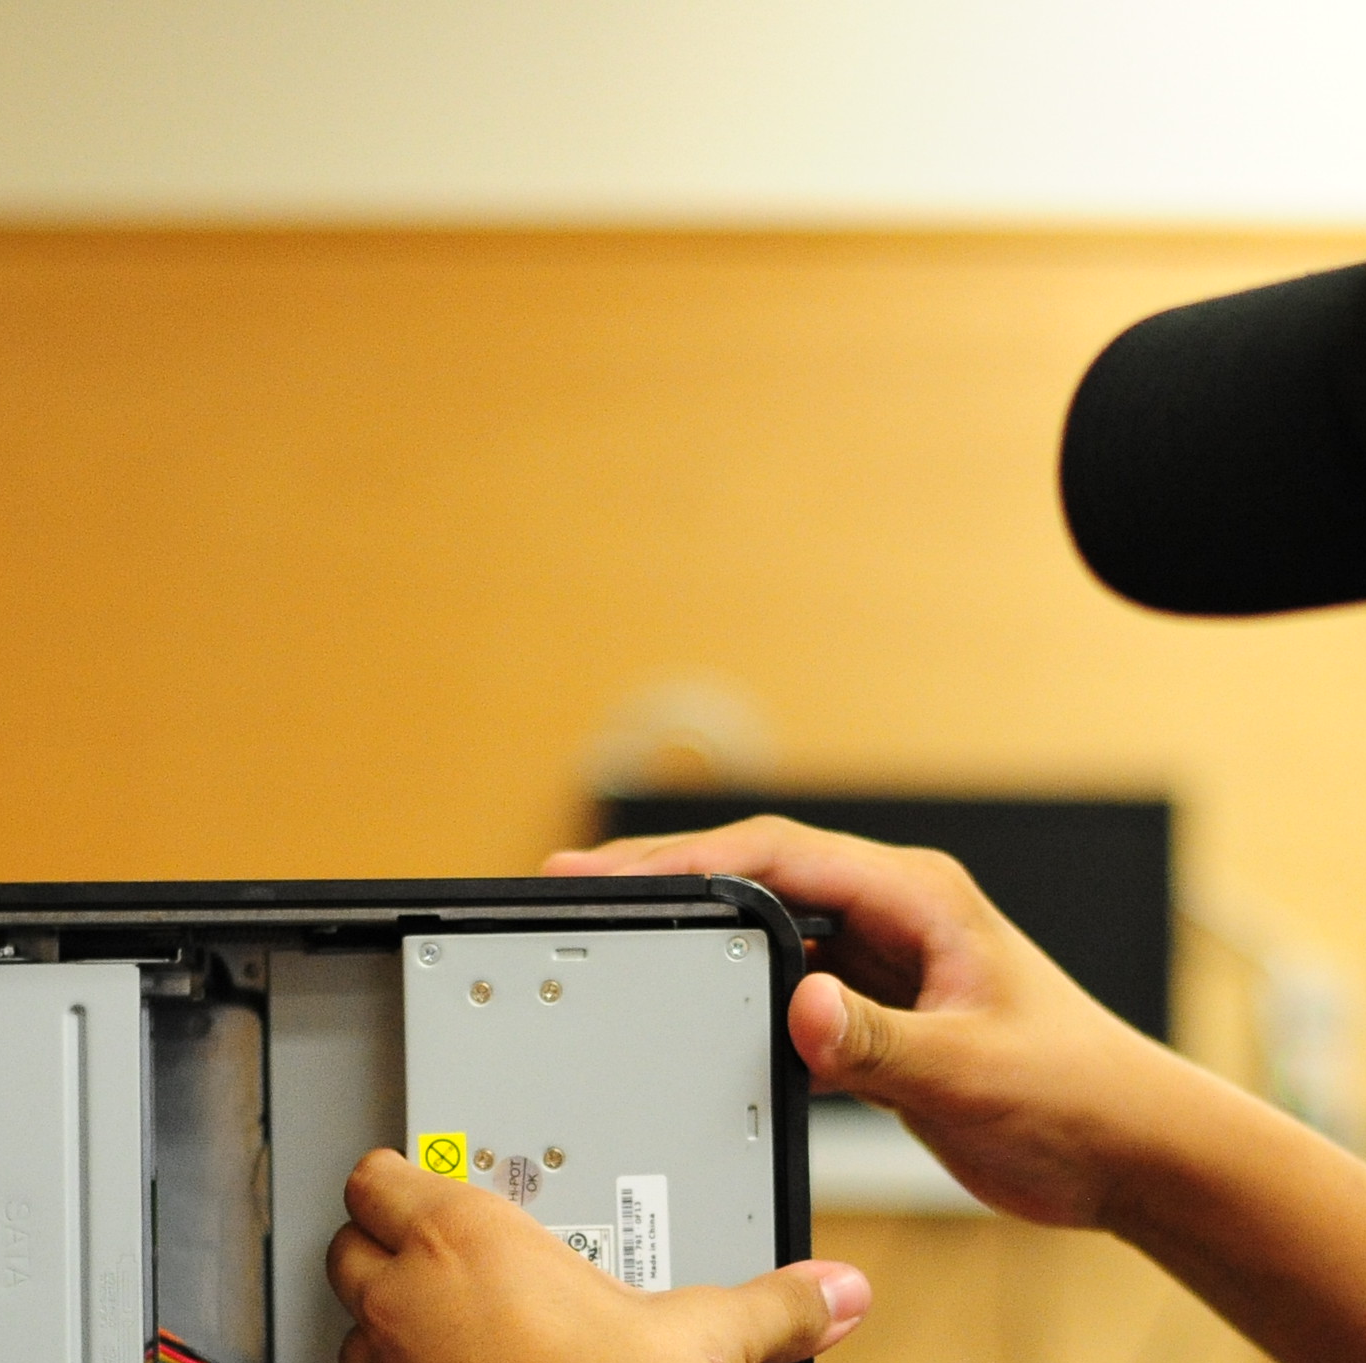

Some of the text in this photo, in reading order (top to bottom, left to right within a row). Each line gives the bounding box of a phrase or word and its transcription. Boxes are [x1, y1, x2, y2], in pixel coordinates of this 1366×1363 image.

[526, 1173, 538, 1192] OK
[3, 1200, 33, 1289] SATA
[647, 1213, 657, 1279] Made in China
